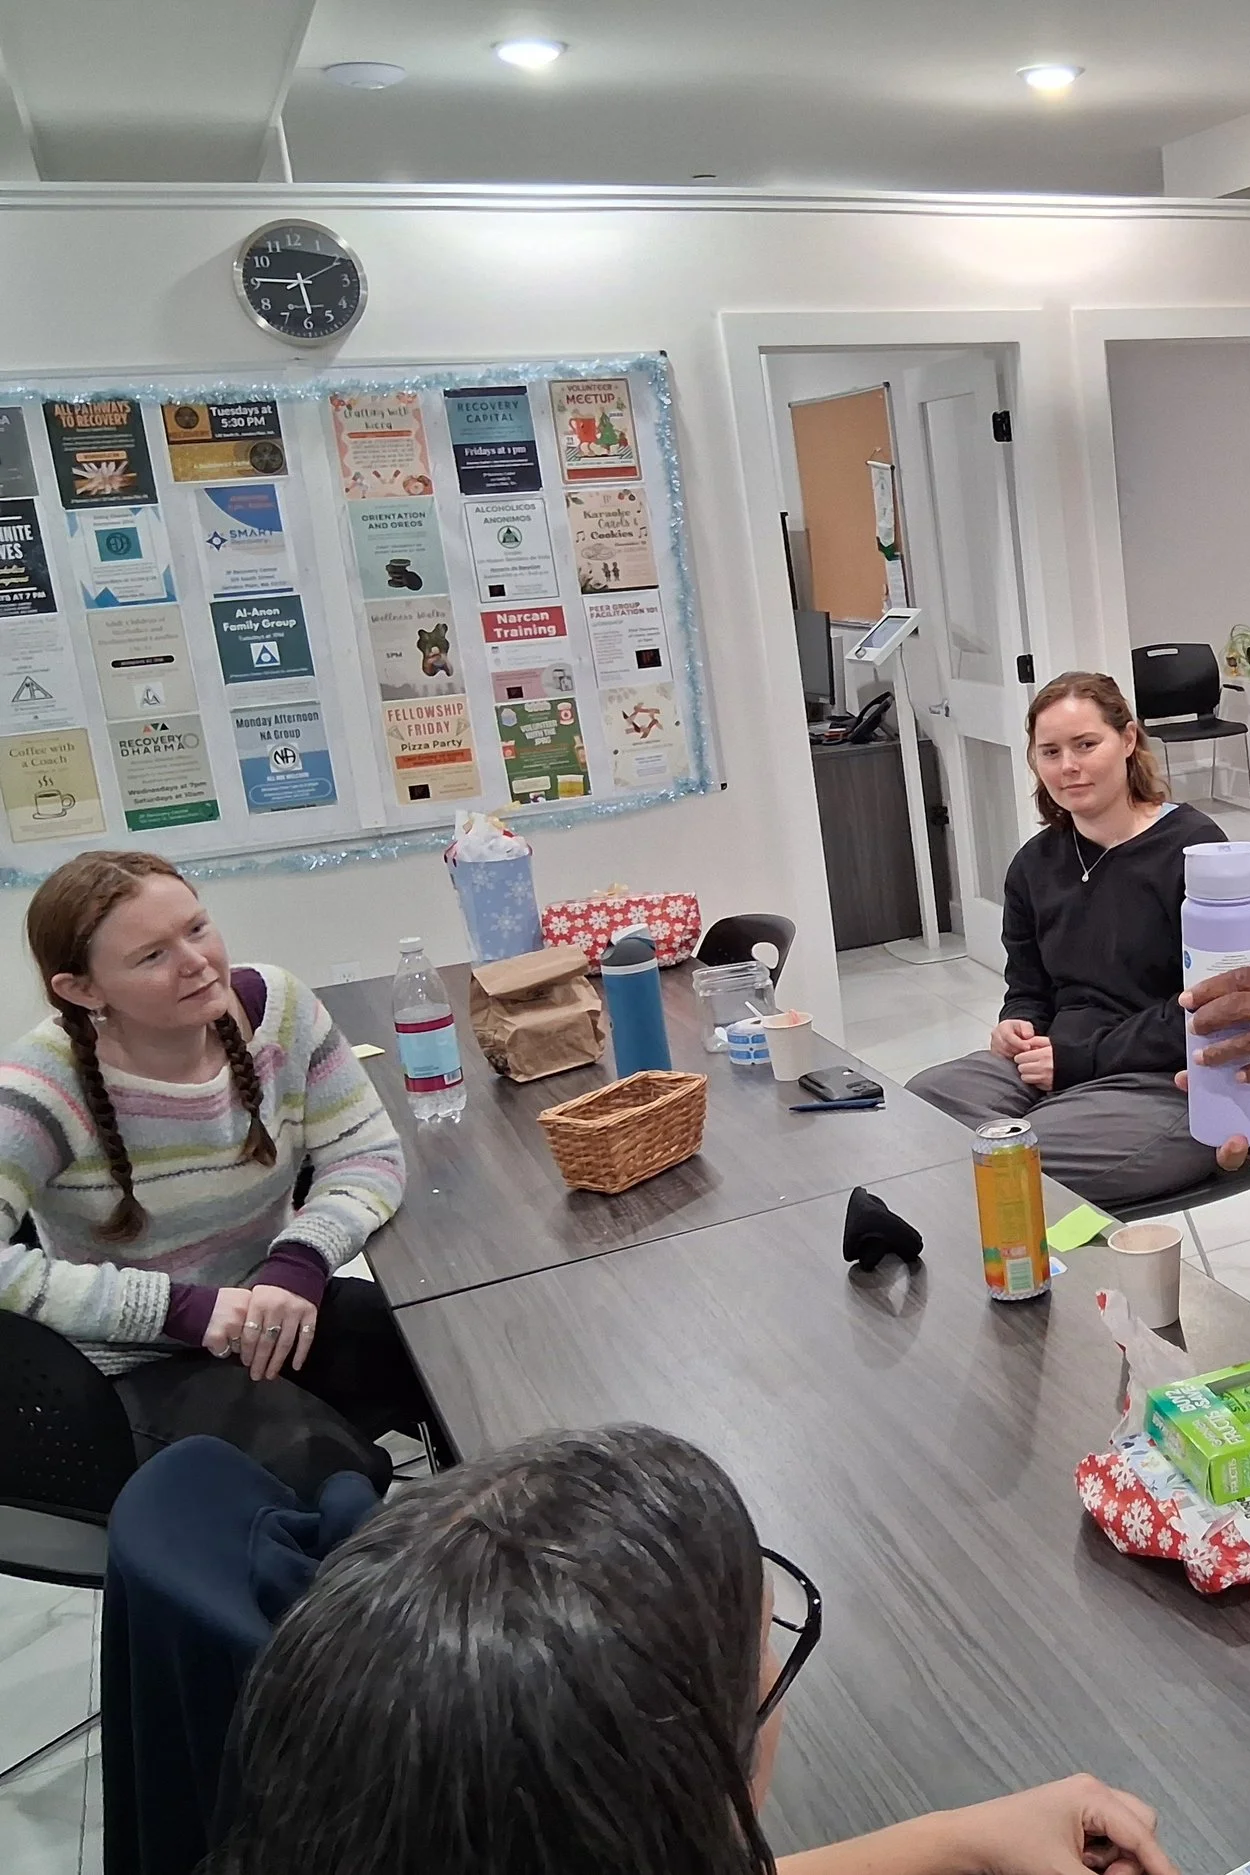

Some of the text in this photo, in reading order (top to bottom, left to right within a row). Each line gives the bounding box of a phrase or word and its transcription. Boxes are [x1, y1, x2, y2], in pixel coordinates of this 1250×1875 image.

[285, 233, 302, 247] 12
[266, 240, 281, 253] 11
[254, 255, 270, 268] 10
[251, 277, 261, 290] 9
[341, 273, 350, 288] 3
[260, 298, 272, 311] 8
[338, 297, 348, 309] 4
[280, 311, 291, 325] 7
[325, 310, 334, 323] 5
[304, 317, 314, 330] 6
[567, 384, 612, 392] VOLUNTEER
[566, 393, 615, 404] MEETUP
[55, 401, 131, 417] ALL PATHWAYS
[209, 405, 273, 417] Tuesdays at
[457, 401, 518, 412] RECOVERY
[60, 413, 128, 428] TO RECOVERY
[221, 416, 266, 428] 5:30 PM
[467, 413, 514, 423] CAPITAL
[464, 446, 496, 456] Fridays
[497, 446, 505, 454] at
[512, 446, 526, 455] pm
[475, 503, 536, 513] ALCOHOLICOS
[583, 509, 631, 519] Karaoke
[361, 511, 426, 521] ORIENTATION
[390, 520, 423, 528] OREOS
[229, 529, 273, 539] SMART
[590, 530, 634, 540] Cookies
[13, 592, 24, 601] AT
[25, 592, 31, 600] 7
[32, 590, 47, 599] PM
[589, 601, 640, 612] PEER GROUP
[235, 607, 281, 619] Al-Anon
[496, 611, 550, 624] Narcan
[590, 608, 645, 619] FACILITATION
[223, 618, 297, 632] Family Group
[493, 624, 557, 638] Training
[387, 702, 464, 722] FELLOWSHIP
[236, 712, 319, 728] Monday Afternoon
[260, 729, 301, 740] NA Group
[407, 720, 450, 737] FRIDAY
[119, 734, 183, 748] RECOVERY
[401, 739, 463, 752] Pizza Party
[9, 742, 76, 758] Coffee with
[120, 743, 185, 757] DHARMA
[30, 755, 68, 767] Coach
[127, 785, 179, 796] Wednesdays
[134, 795, 173, 805] Saturdays
[1205, 1410, 1244, 1444] FRUCTIS
